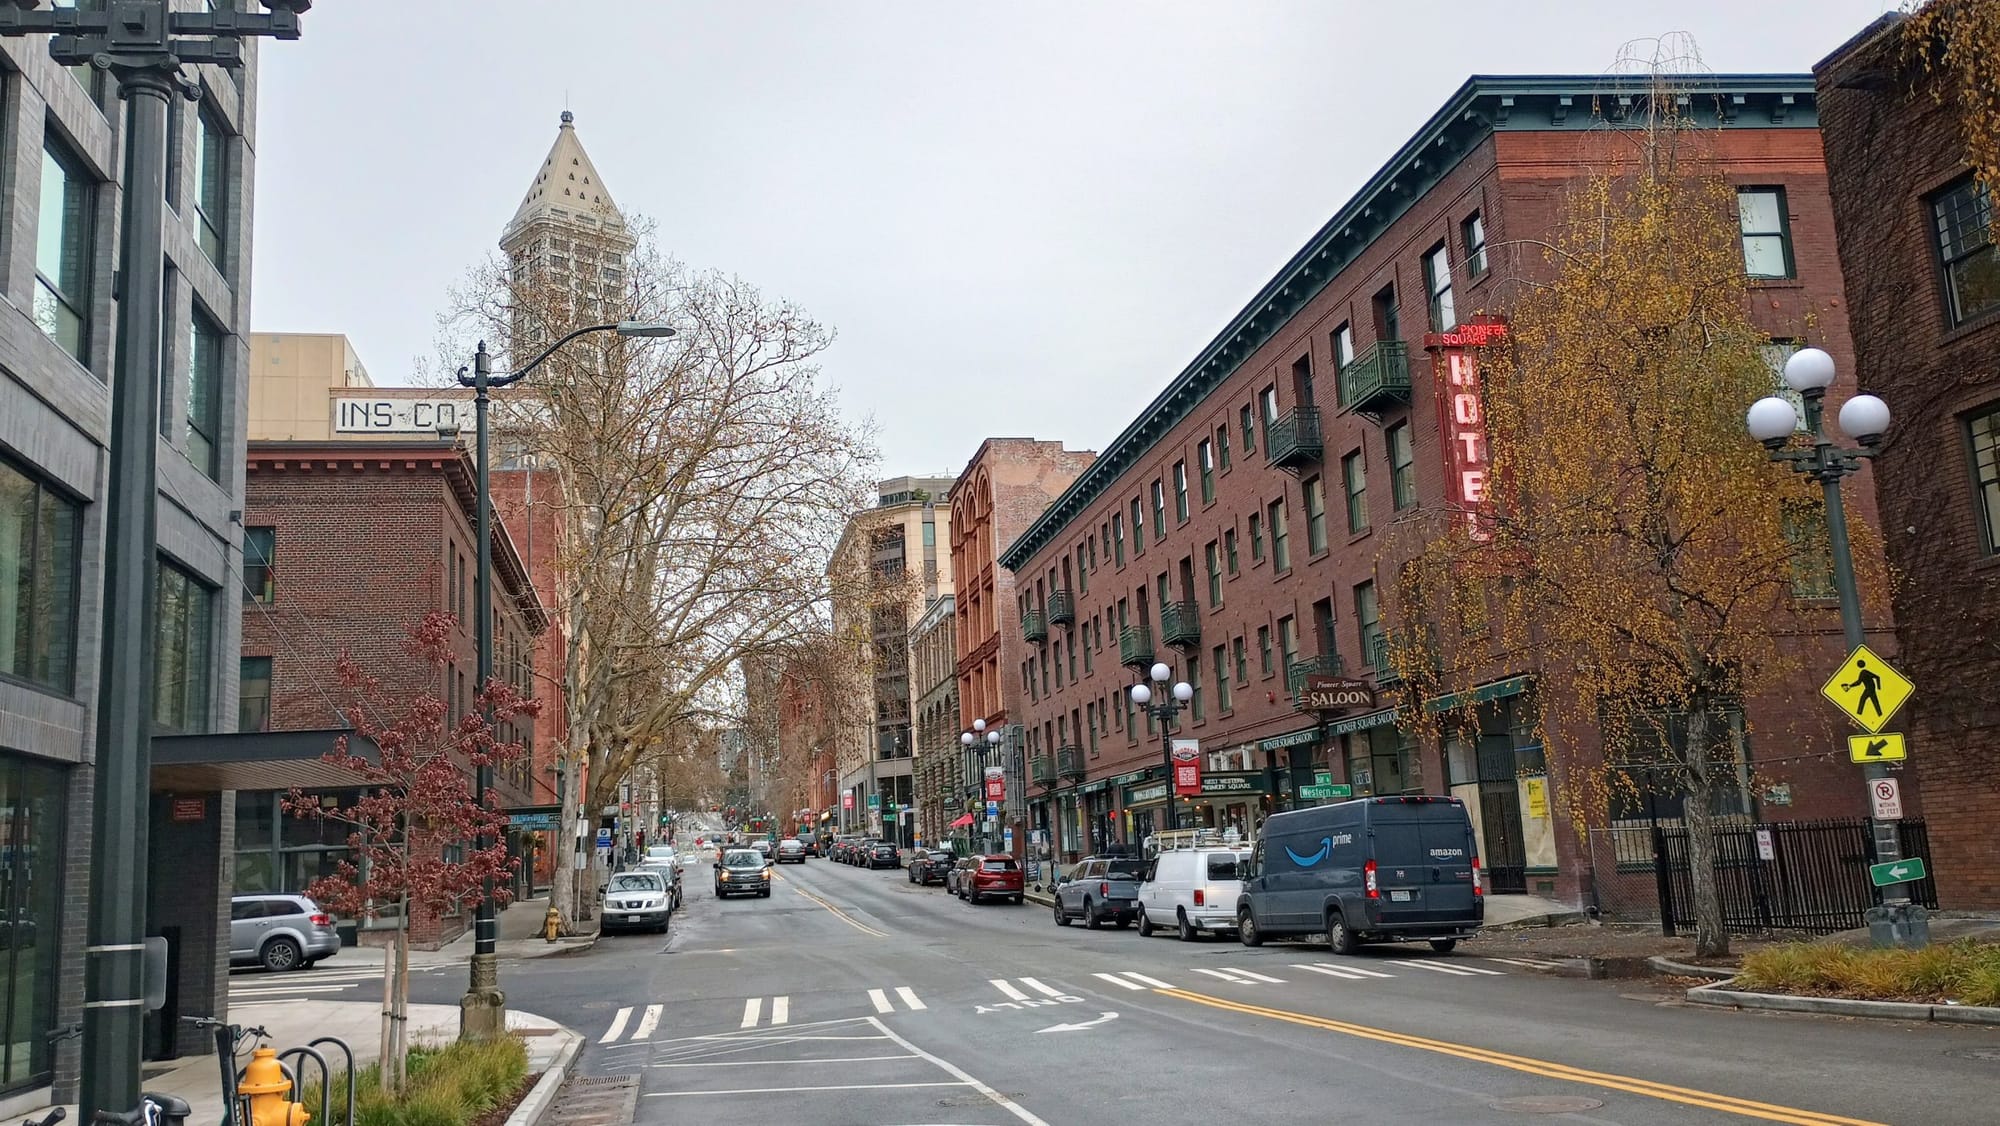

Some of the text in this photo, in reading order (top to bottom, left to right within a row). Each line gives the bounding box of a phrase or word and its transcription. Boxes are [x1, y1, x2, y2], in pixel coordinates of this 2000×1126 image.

[1442, 333, 1486, 345] SQUARE
[1450, 355, 1491, 541] HOTEL
[1316, 680, 1362, 690] Pioneer Square
[1311, 691, 1370, 707] SALOON
[1336, 721, 1356, 734] PIONEER
[1357, 716, 1377, 730] SQUARE
[1263, 732, 1313, 751] PIONEER SQUARE SALOON
[1302, 788, 1331, 797] Western
[1332, 831, 1352, 848] prime
[1429, 848, 1463, 857] amazon
